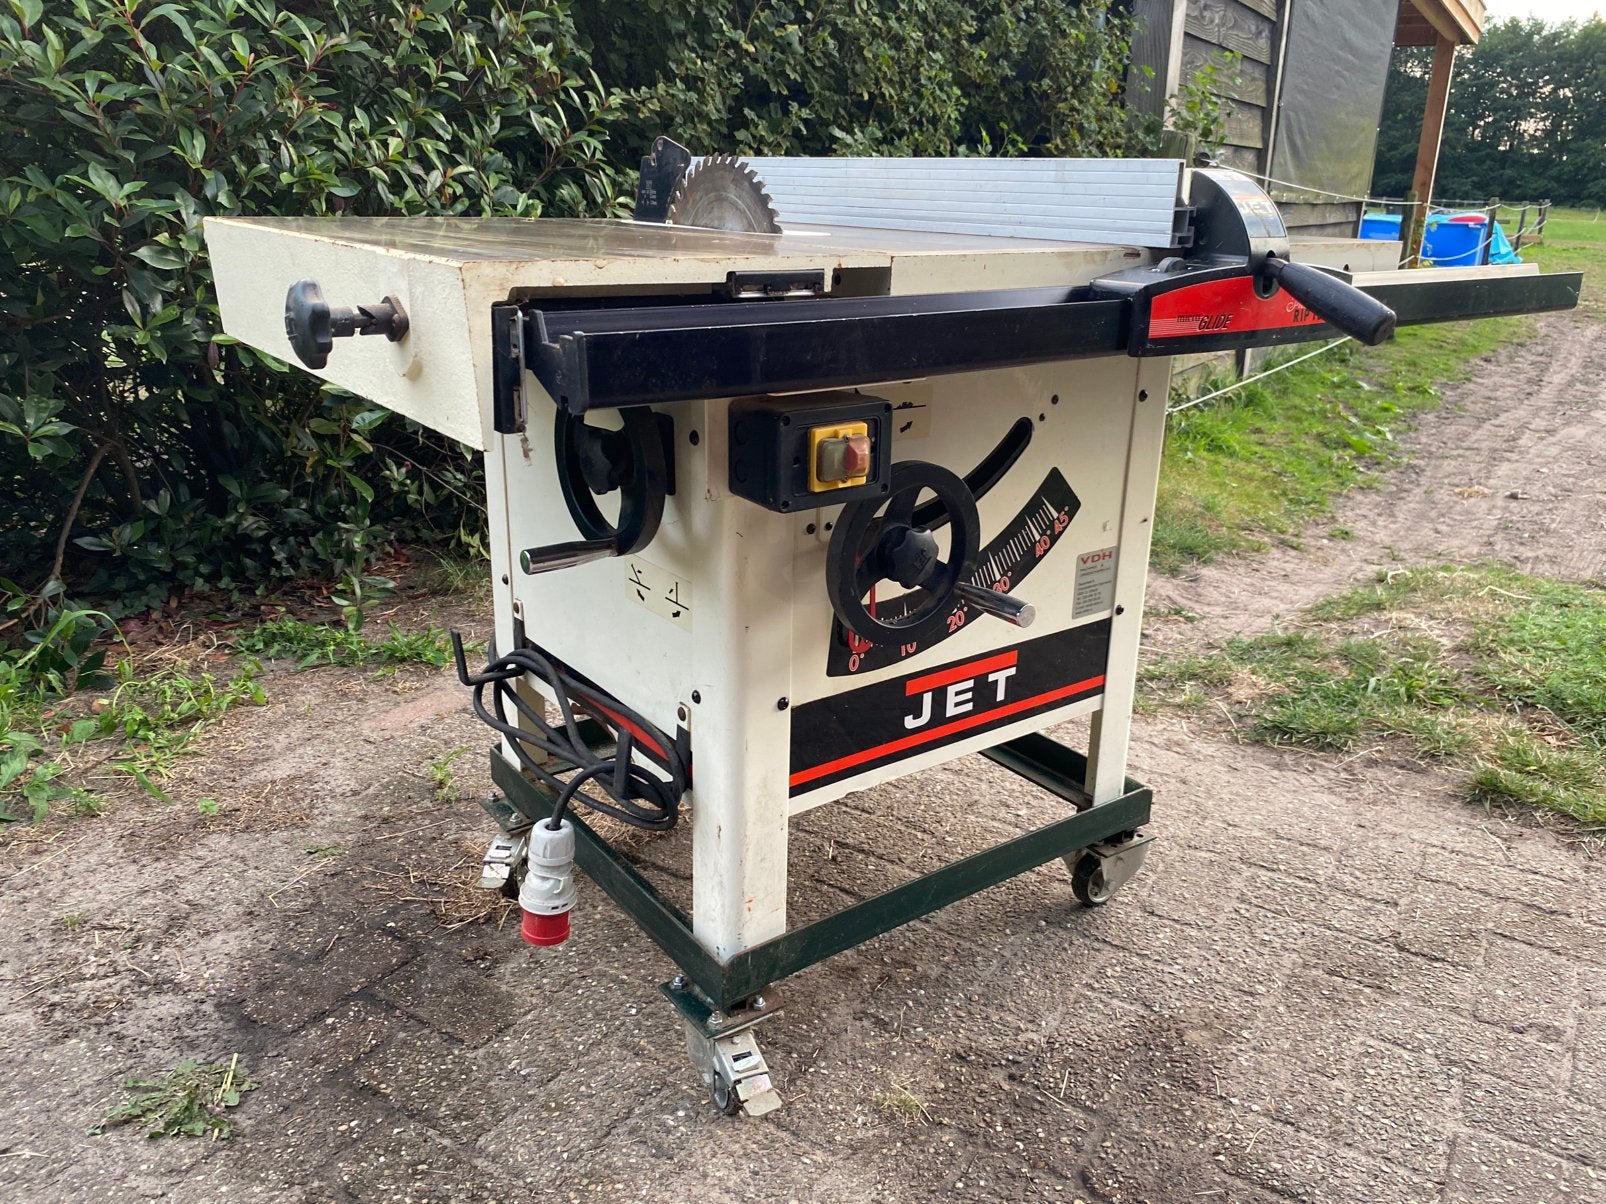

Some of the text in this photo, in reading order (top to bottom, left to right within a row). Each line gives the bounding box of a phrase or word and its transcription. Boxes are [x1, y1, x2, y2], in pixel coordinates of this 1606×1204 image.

[1198, 313, 1234, 332] GLIDE
[1080, 551, 1113, 565] VDH
[904, 666, 1017, 730] JET
